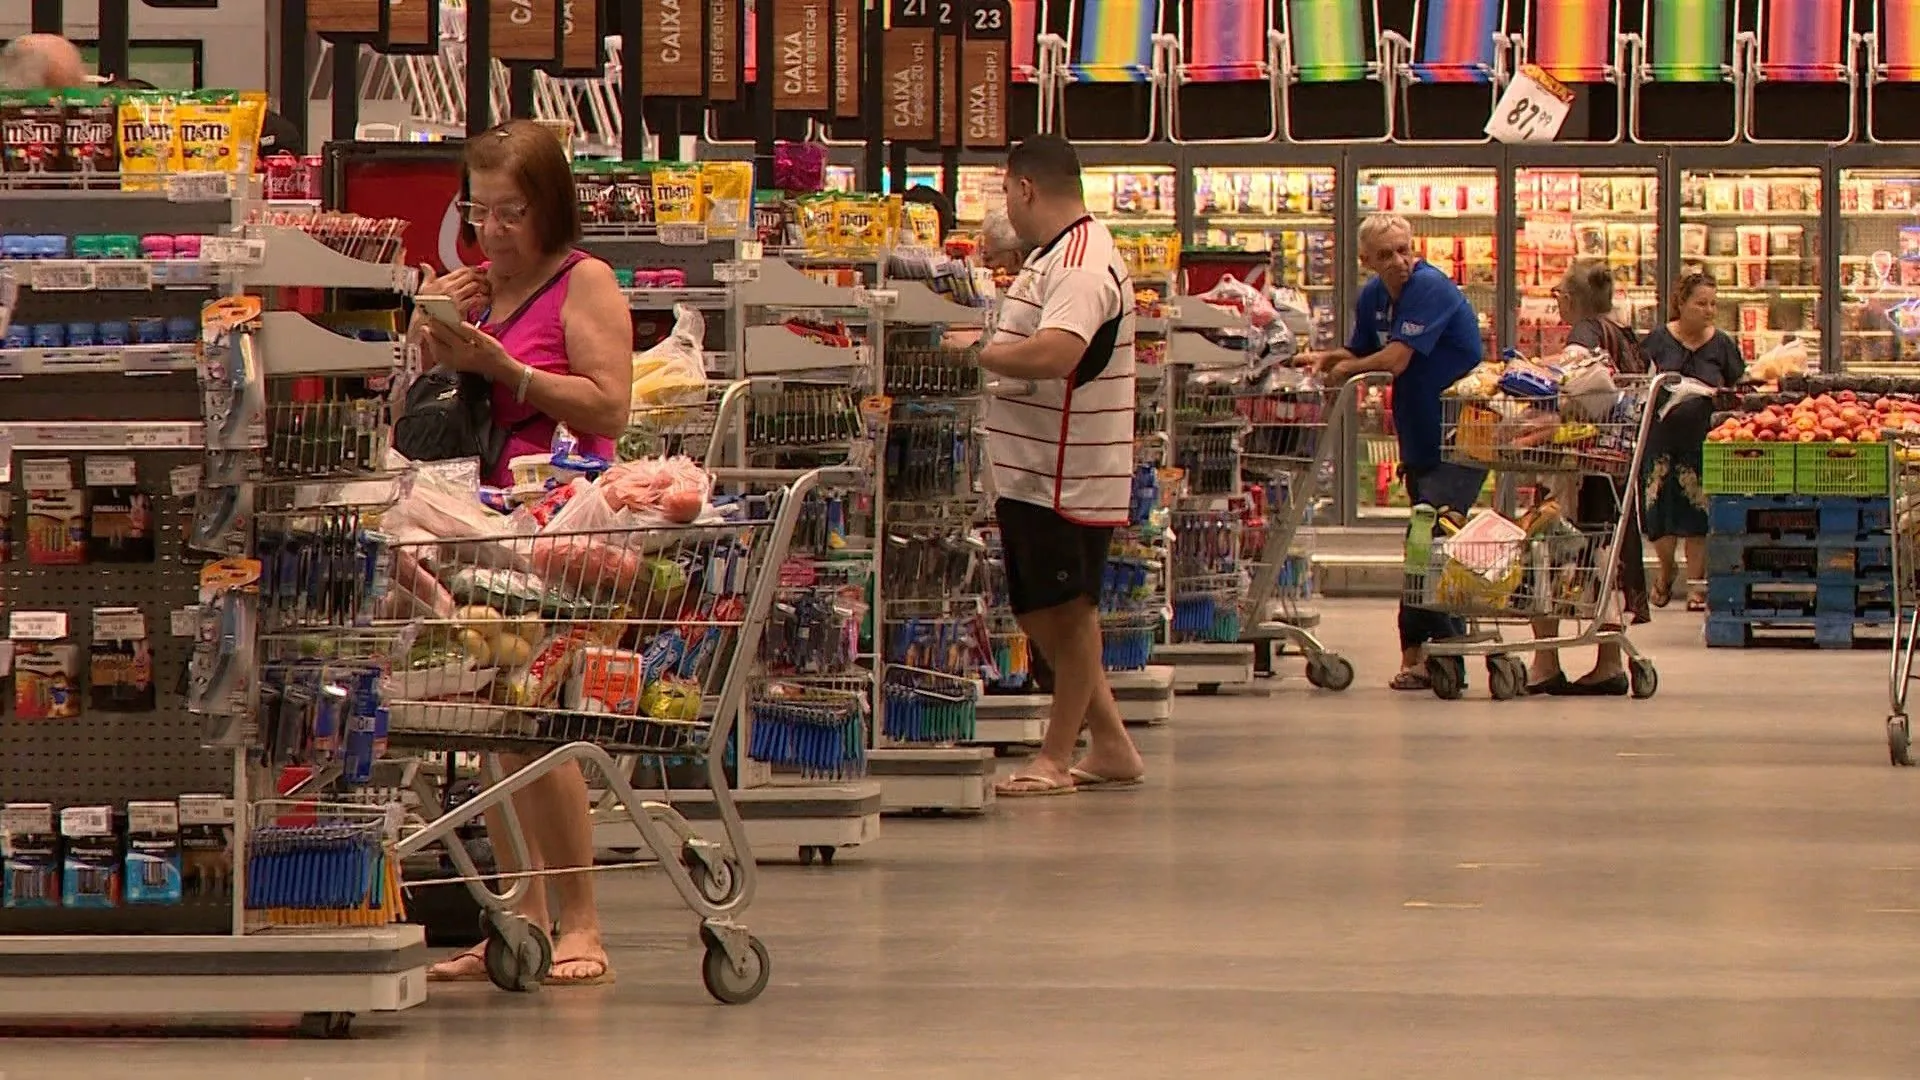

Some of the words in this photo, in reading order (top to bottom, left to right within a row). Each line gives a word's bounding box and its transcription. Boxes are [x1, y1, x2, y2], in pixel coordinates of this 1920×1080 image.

[803, 4, 820, 93] preferencial
[974, 9, 1001, 30] 23
[784, 31, 802, 94] CAIXA
[893, 69, 910, 127] CAIXA
[969, 84, 986, 138] CAIXA
